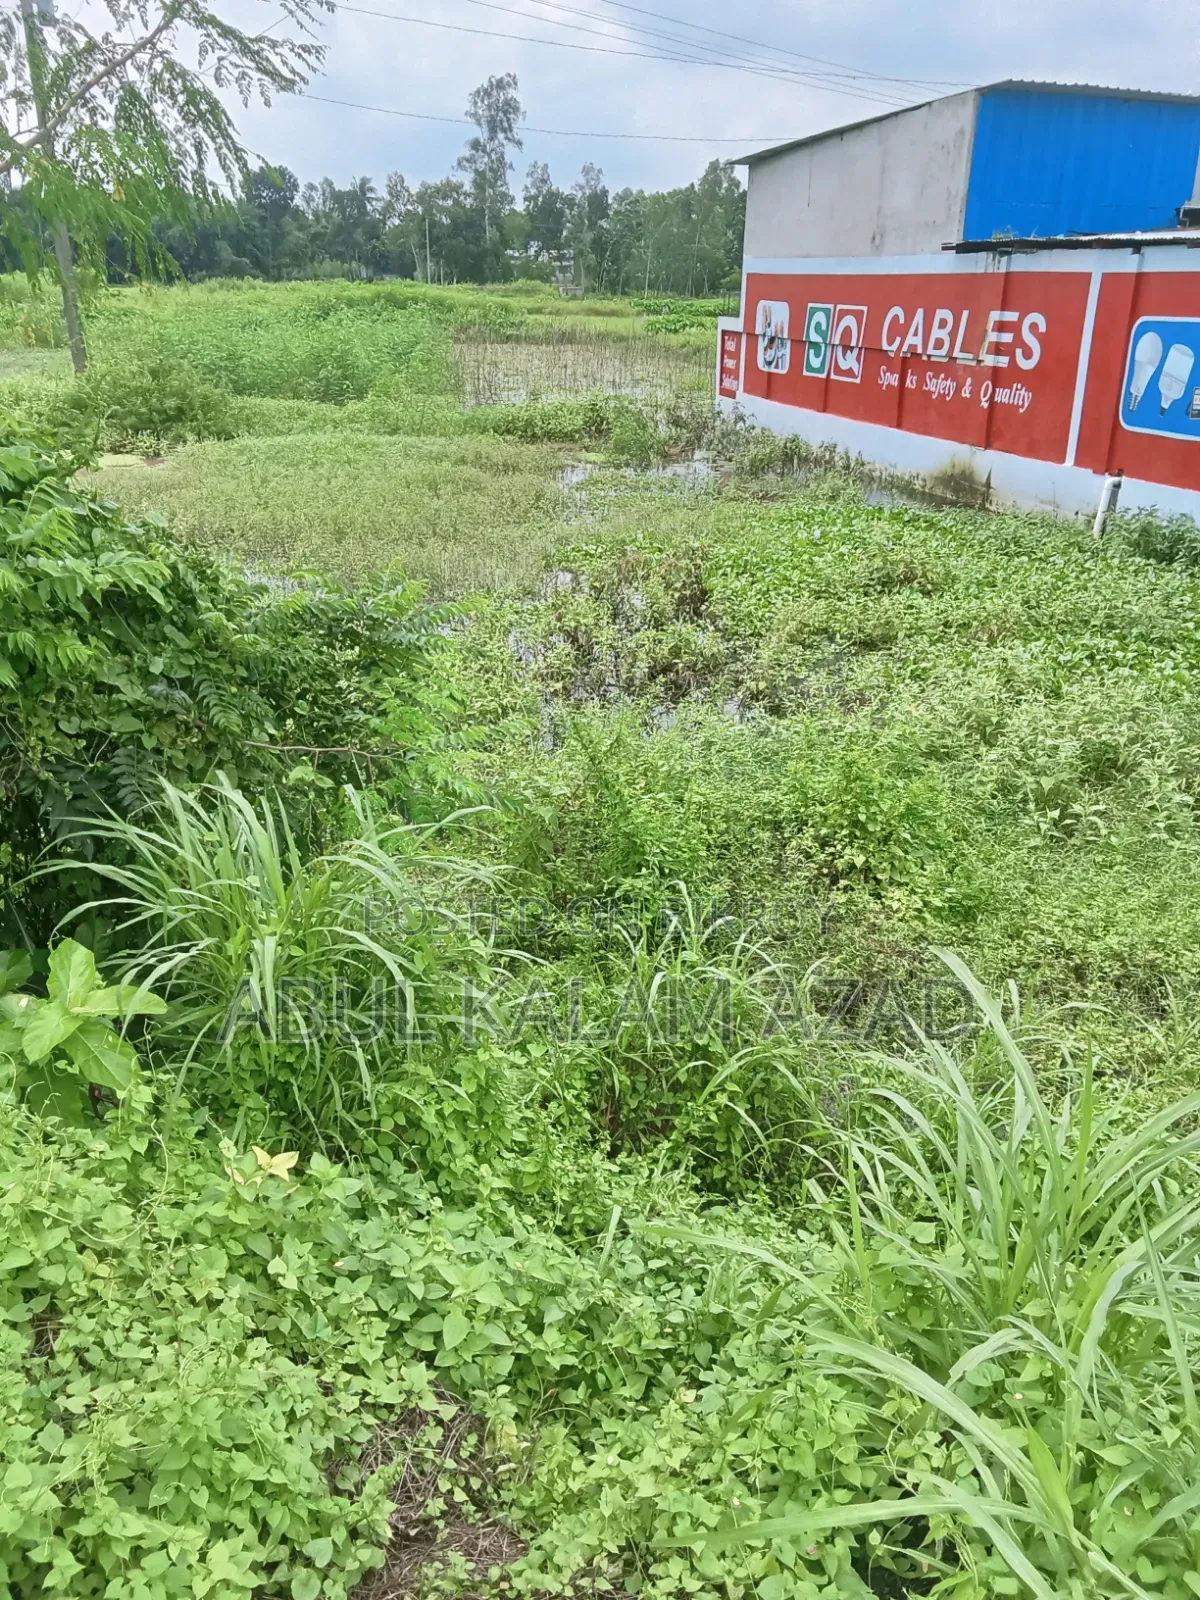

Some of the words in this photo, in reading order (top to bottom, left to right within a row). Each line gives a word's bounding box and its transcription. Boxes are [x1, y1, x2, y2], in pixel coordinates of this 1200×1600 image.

[881, 306, 1047, 370] CABLES
[923, 371, 956, 401] Safety
[961, 377, 972, 399] &
[980, 380, 1032, 413] Quality
